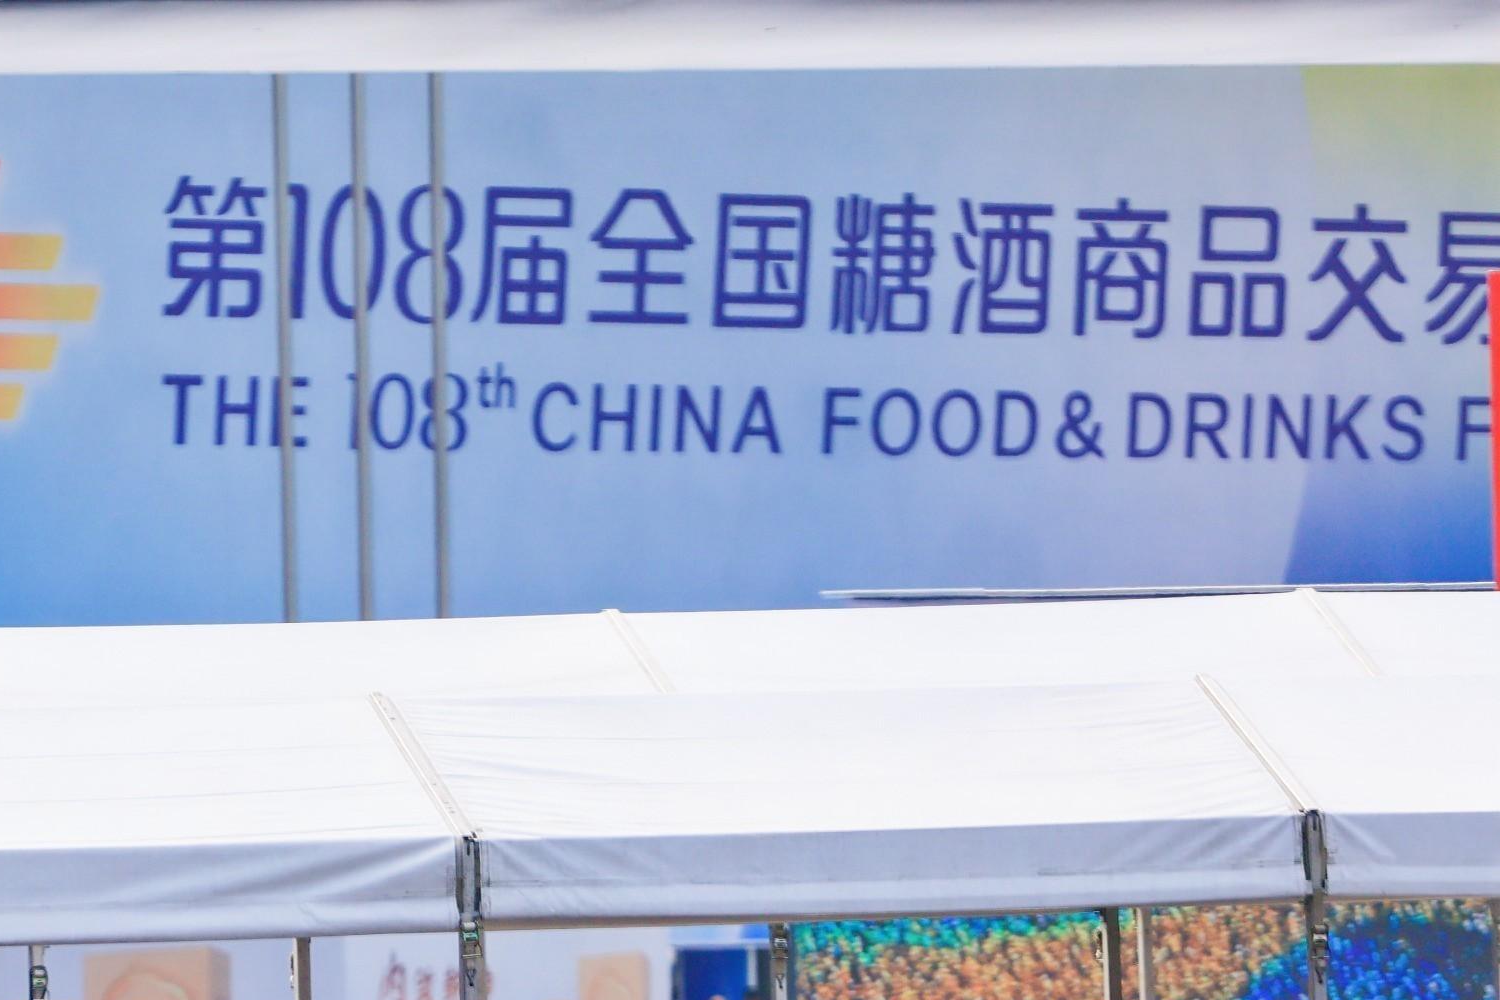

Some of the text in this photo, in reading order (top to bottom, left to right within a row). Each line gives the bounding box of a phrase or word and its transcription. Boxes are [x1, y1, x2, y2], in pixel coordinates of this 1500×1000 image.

[162, 175, 1500, 343] 第108届全国糖酒商品交易
[162, 374, 310, 447] THE
[532, 381, 783, 455] CHINA
